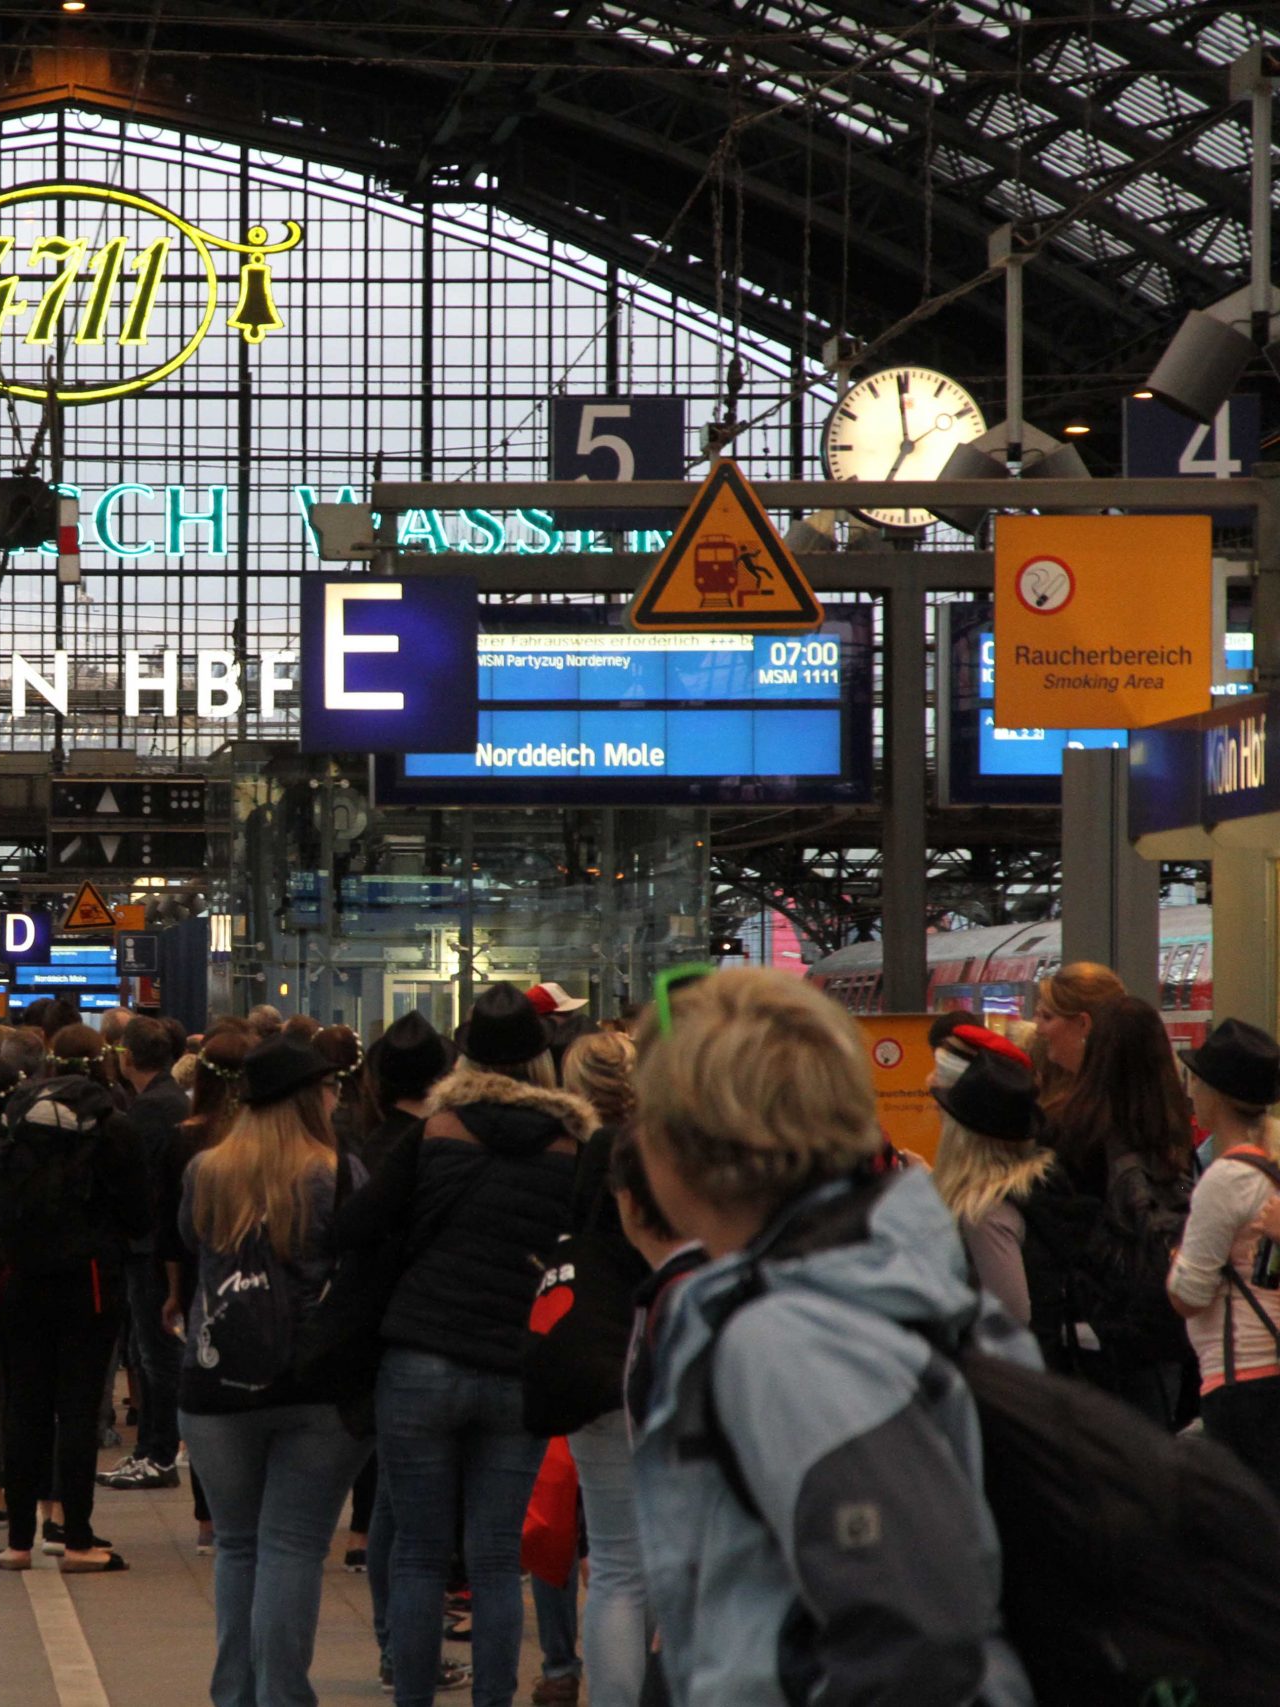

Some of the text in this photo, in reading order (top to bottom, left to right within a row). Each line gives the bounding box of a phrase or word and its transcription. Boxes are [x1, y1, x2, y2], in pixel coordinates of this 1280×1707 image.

[575, 404, 635, 481] 5
[324, 582, 405, 711] E
[770, 641, 839, 667] 07:00
[1014, 645, 1193, 666] Raucherbereich
[507, 654, 564, 670] Partyzug
[566, 654, 631, 670] Norderney
[125, 650, 296, 718] HBF
[759, 669, 839, 685] MSM 1111
[1043, 673, 1165, 692] Smoking Area
[475, 742, 665, 768] Norddeich Mole
[1240, 713, 1267, 790] Hbf
[5, 913, 36, 953] D
